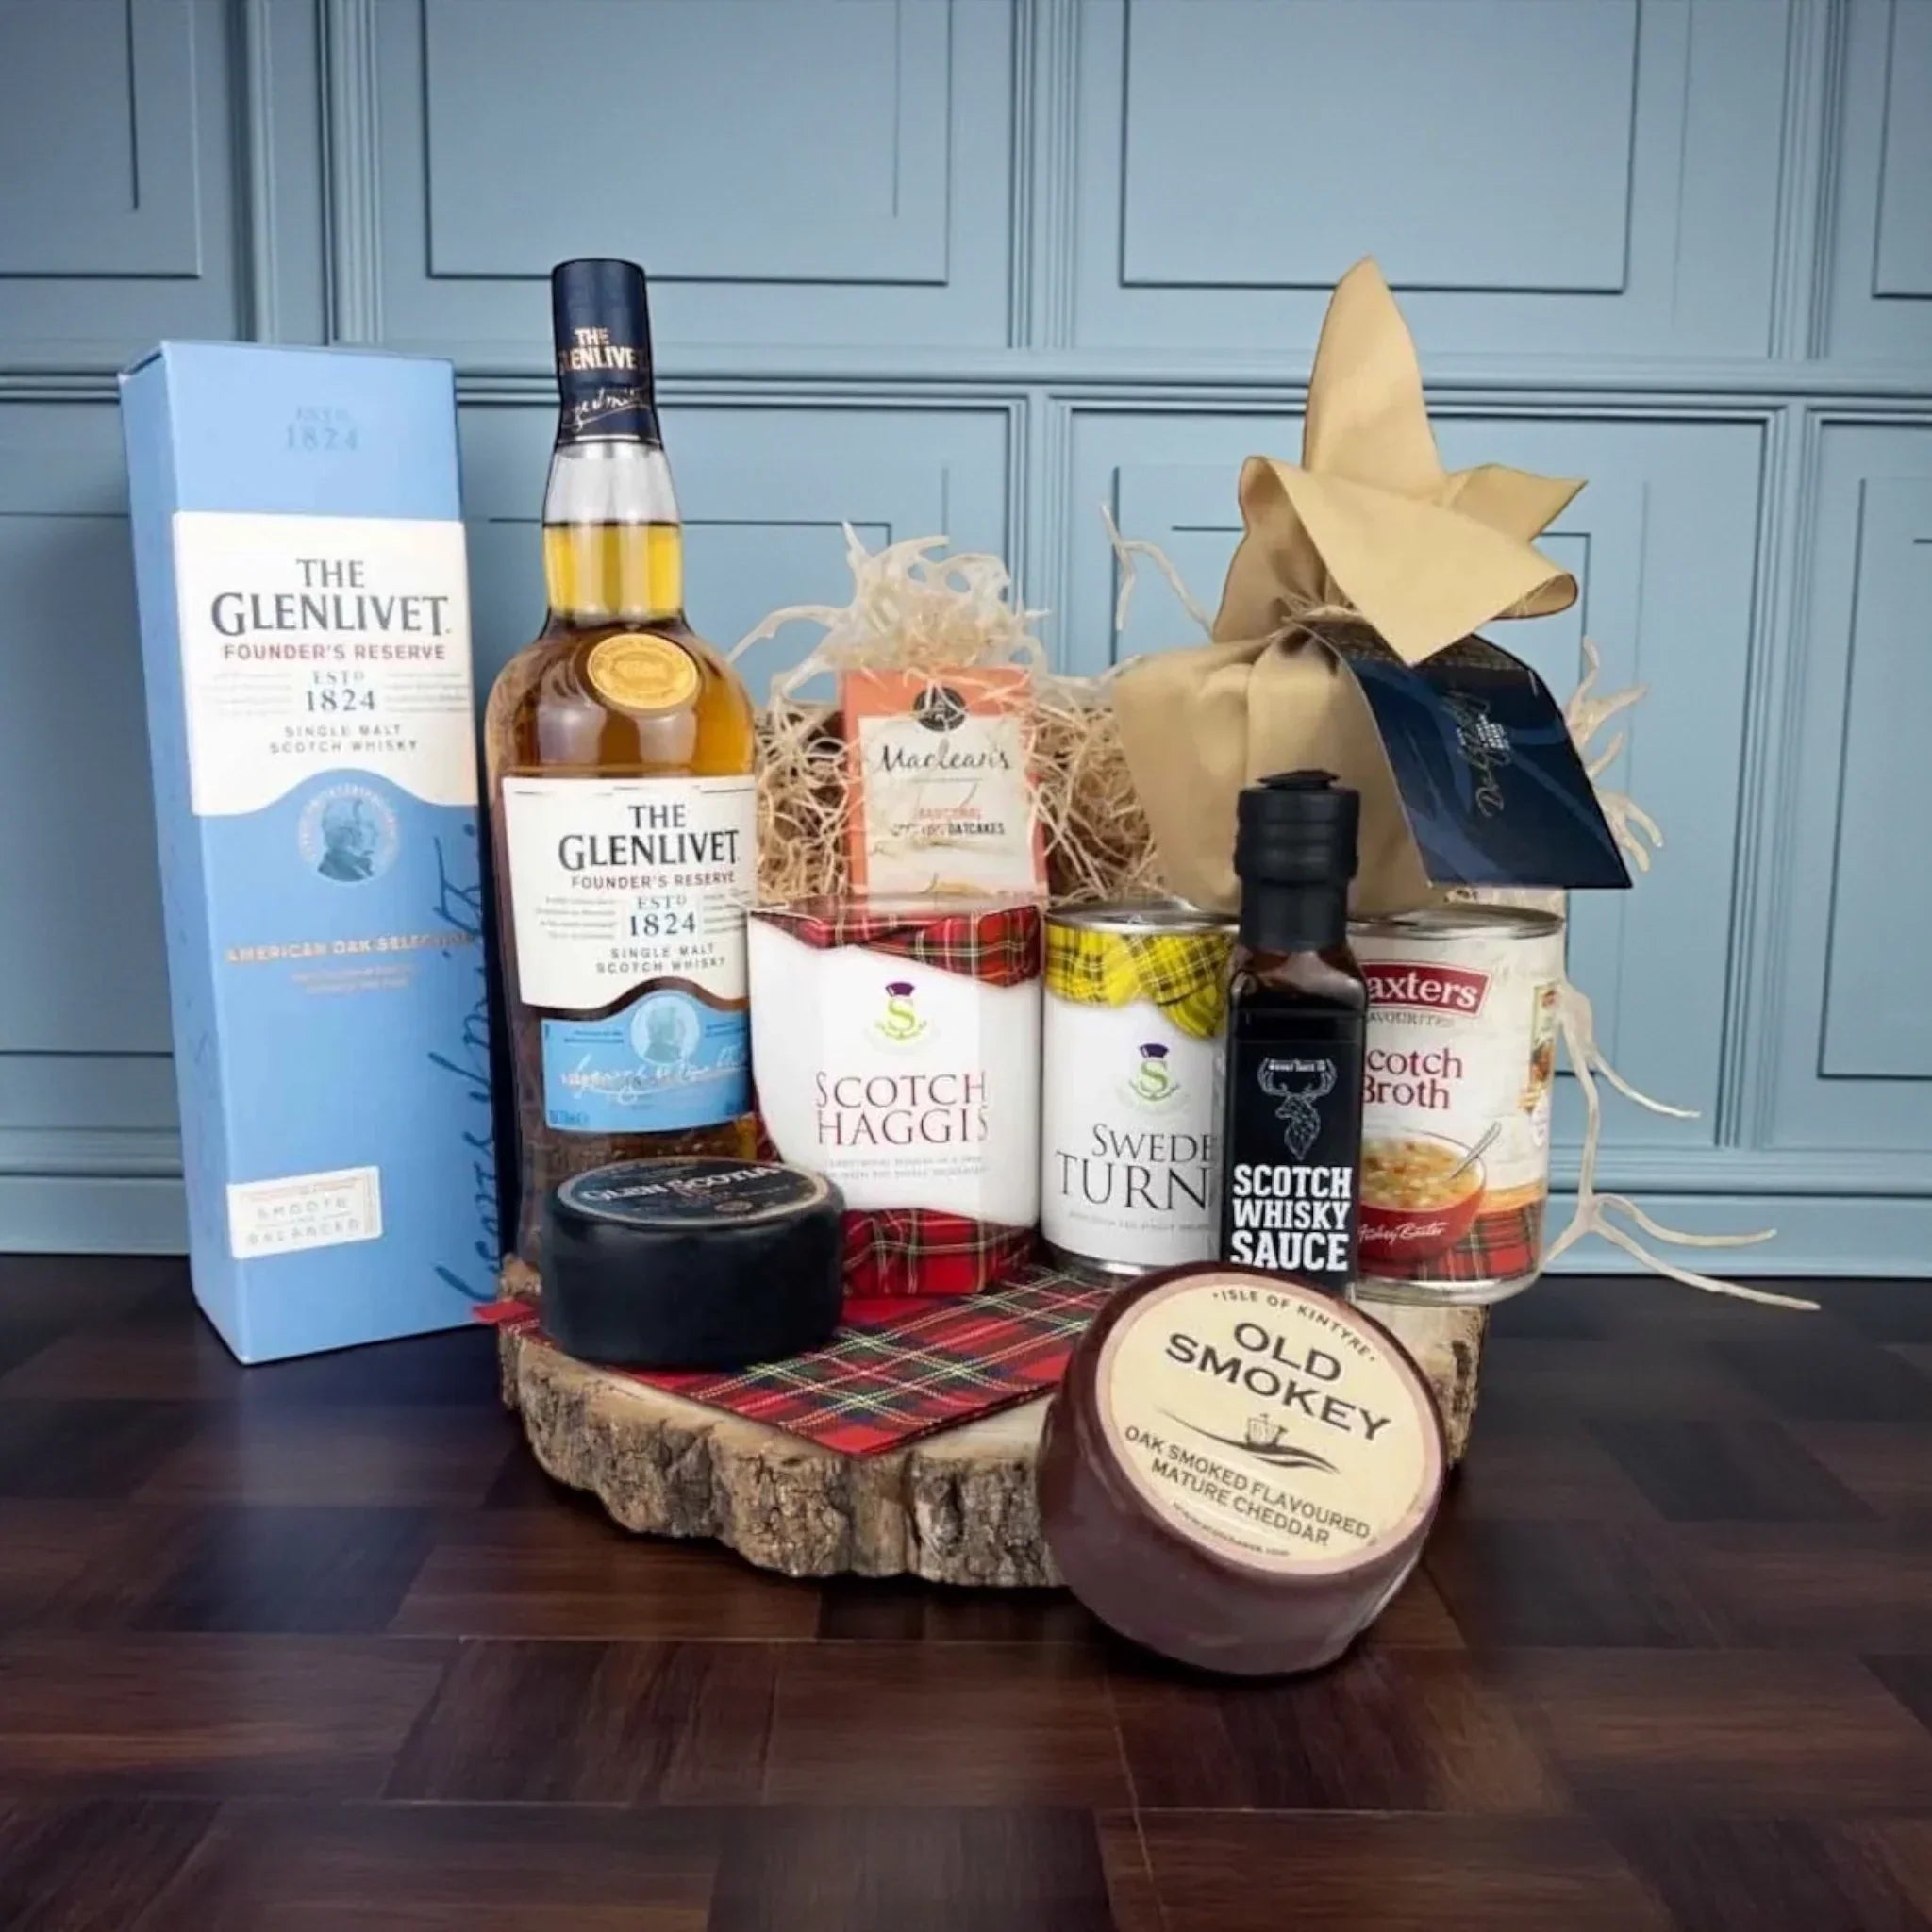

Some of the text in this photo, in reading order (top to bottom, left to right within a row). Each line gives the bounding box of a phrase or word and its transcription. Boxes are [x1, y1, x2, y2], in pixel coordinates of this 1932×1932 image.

[574, 327, 610, 346] THE
[296, 558, 364, 588] THE
[211, 591, 448, 637] GLENLIVET
[224, 644, 446, 660] FOUNDER'S RESERVE
[306, 689, 375, 712] 1824
[270, 739, 417, 754] SCOTCH WHISKY
[285, 724, 401, 738] SINGLE MALT
[874, 740, 1011, 772] Maclean's
[627, 804, 687, 829] THE
[948, 822, 1005, 835] OATCAKES
[558, 830, 740, 872] GLENLIVET
[572, 870, 736, 890] FOUNDER'S RESERVE
[630, 912, 696, 937] 1824
[226, 941, 327, 963] AMERICAN
[333, 939, 372, 955] OAK
[596, 957, 725, 974] SCOTCH WHISKY
[611, 943, 714, 959] SINGLE MALT
[1368, 970, 1478, 1008] axters
[1368, 1047, 1462, 1078] cotch
[815, 1070, 988, 1109] SCOTCH
[816, 1105, 989, 1145] HAGGIS
[1091, 1122, 1216, 1163] SWEDE
[1055, 1149, 1214, 1211] TURN
[1233, 1164, 1352, 1199] SCOTCH
[1232, 1198, 1351, 1230] WHISKY
[1230, 1229, 1349, 1271] SAUCE
[1222, 1289, 1371, 1356] ISLE OF KINTYRE
[1233, 1322, 1341, 1383] OLD
[1165, 1332, 1391, 1441] SMOKEY
[1124, 1425, 1163, 1455] OAK
[1168, 1444, 1248, 1492] SMOKED
[1251, 1483, 1372, 1540] FLAVOURED
[1151, 1458, 1231, 1507] MATURE
[1233, 1495, 1331, 1547] CHEDDAR
